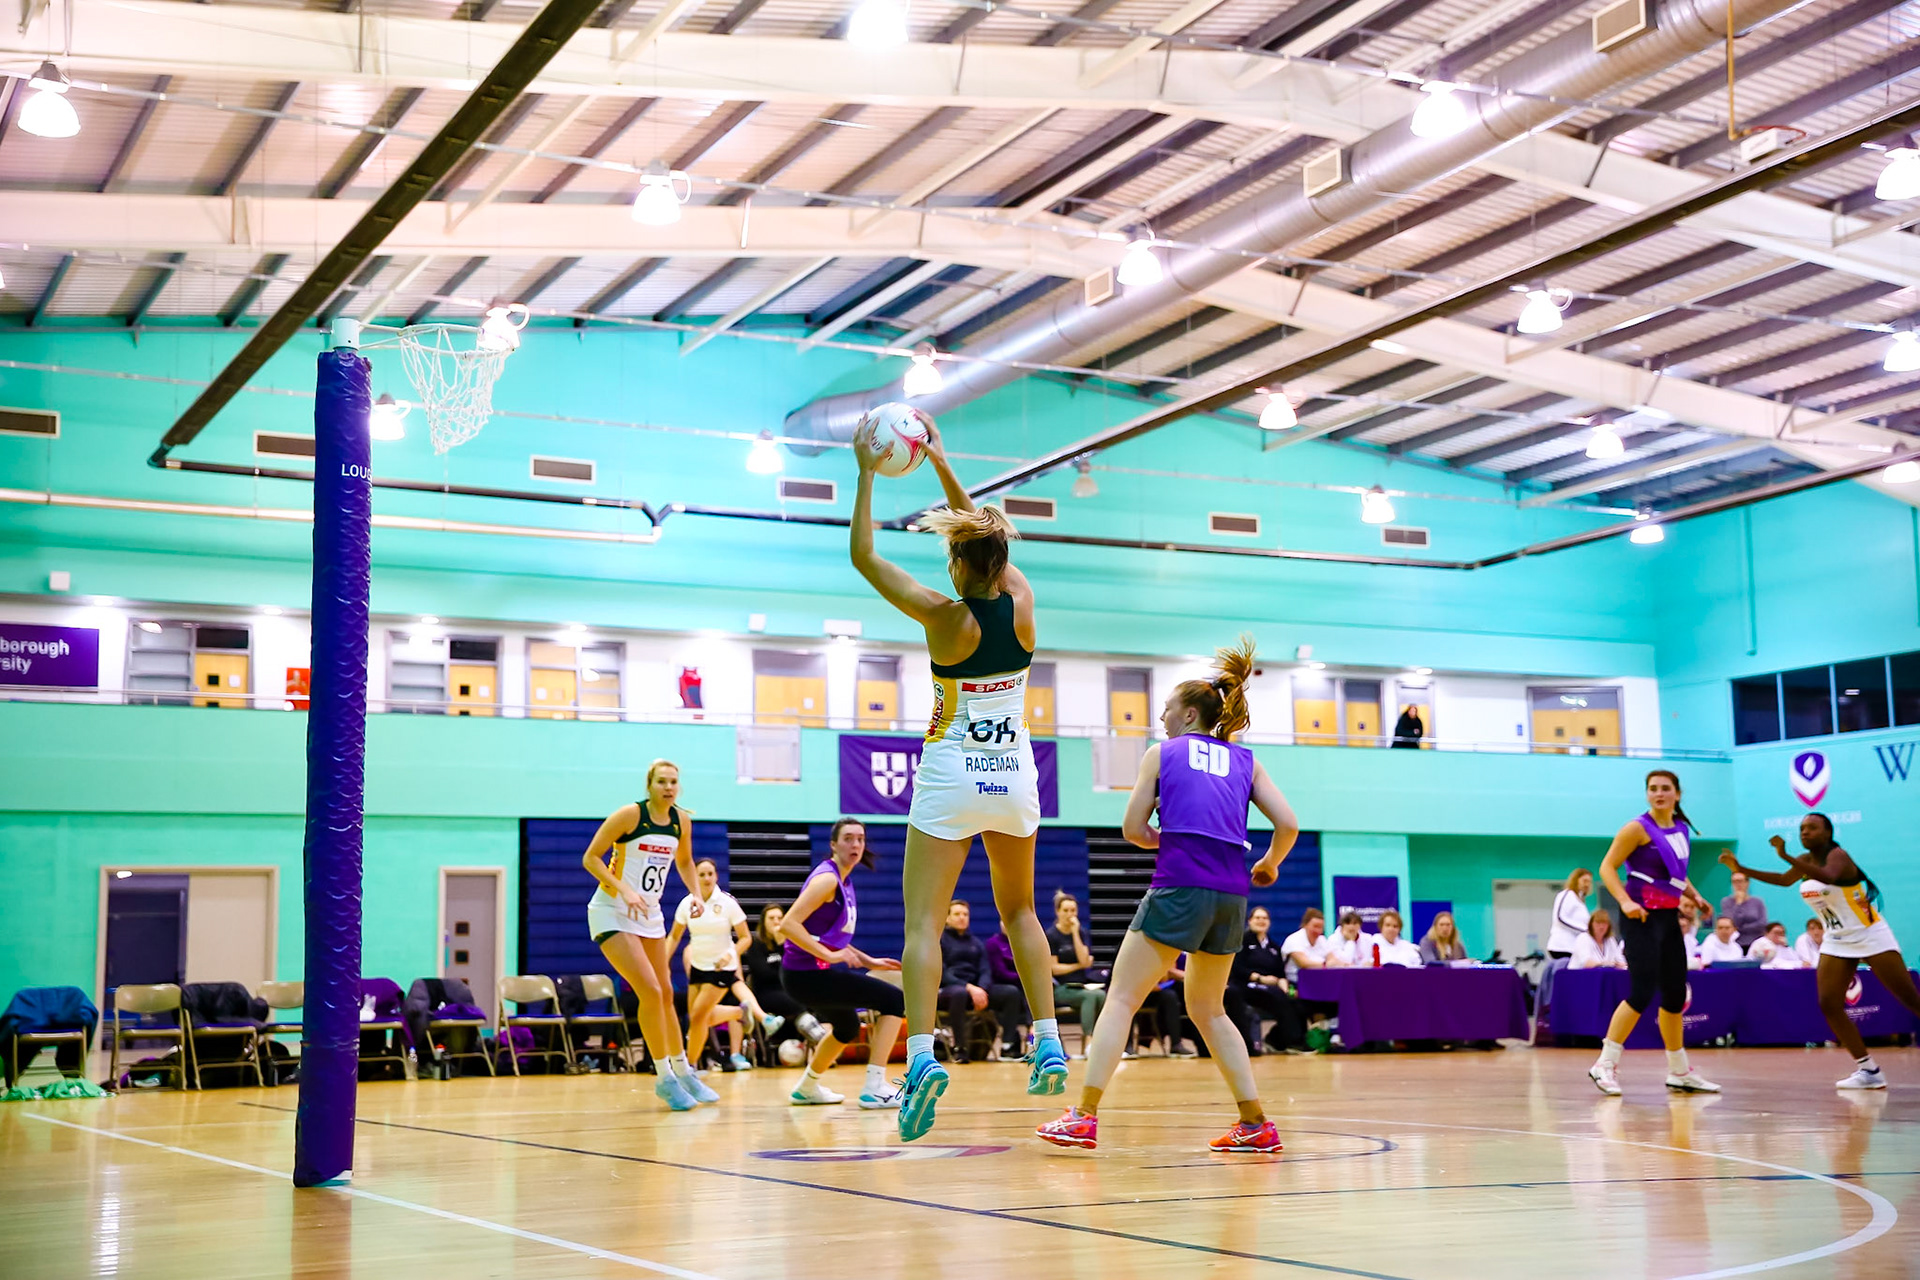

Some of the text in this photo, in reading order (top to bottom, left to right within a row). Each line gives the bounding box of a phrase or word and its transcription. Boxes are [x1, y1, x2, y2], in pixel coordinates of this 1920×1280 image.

[0, 637, 70, 658] borough
[975, 679, 1015, 693] SPAR
[965, 756, 1020, 772] RADEMAN
[1188, 738, 1231, 778] GD
[1874, 742, 1918, 782] W
[975, 782, 1009, 794] Twizza
[642, 865, 667, 893] GS
